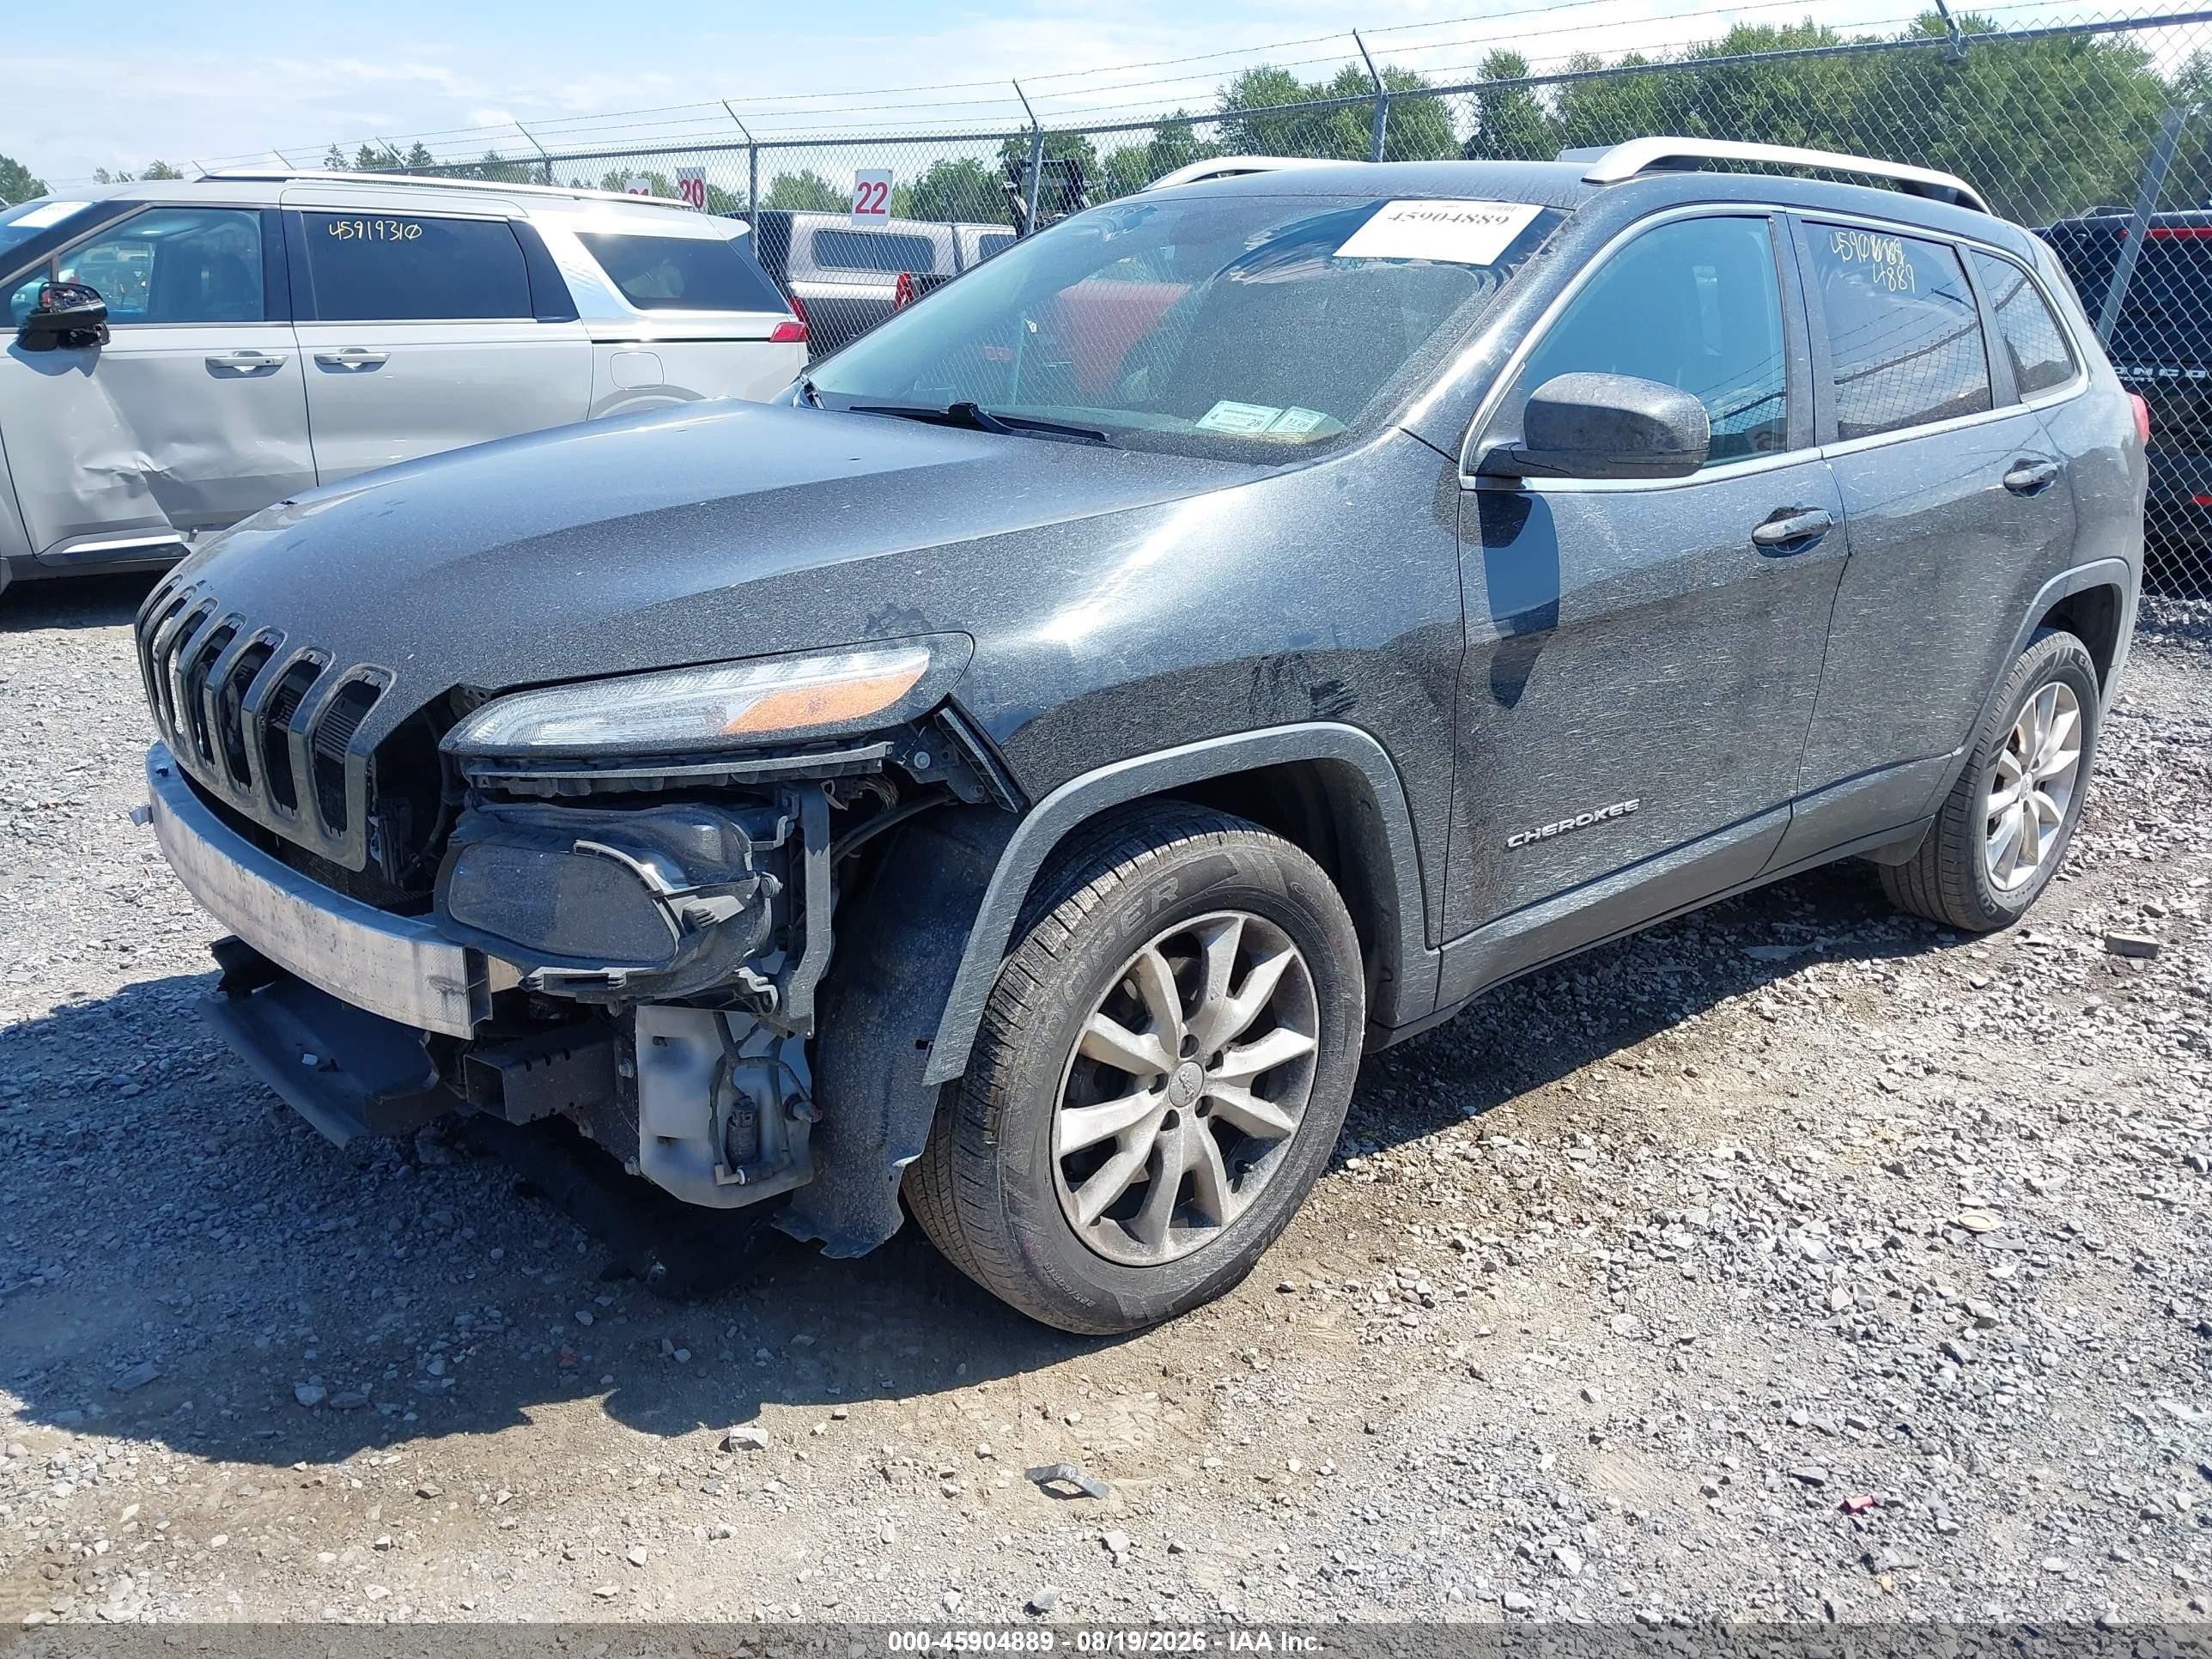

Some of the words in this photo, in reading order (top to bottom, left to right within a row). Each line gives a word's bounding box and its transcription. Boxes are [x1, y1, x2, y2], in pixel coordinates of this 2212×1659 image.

[679, 179, 704, 209] 20
[855, 181, 888, 214] 22
[329, 220, 422, 241] 45919310
[1387, 210, 1510, 226] 45904889
[1873, 262, 1916, 295] 4889
[2112, 366, 2206, 378] ONCO
[1247, 418, 1264, 428] 28
[1507, 799, 1640, 848] CHEROKEE
